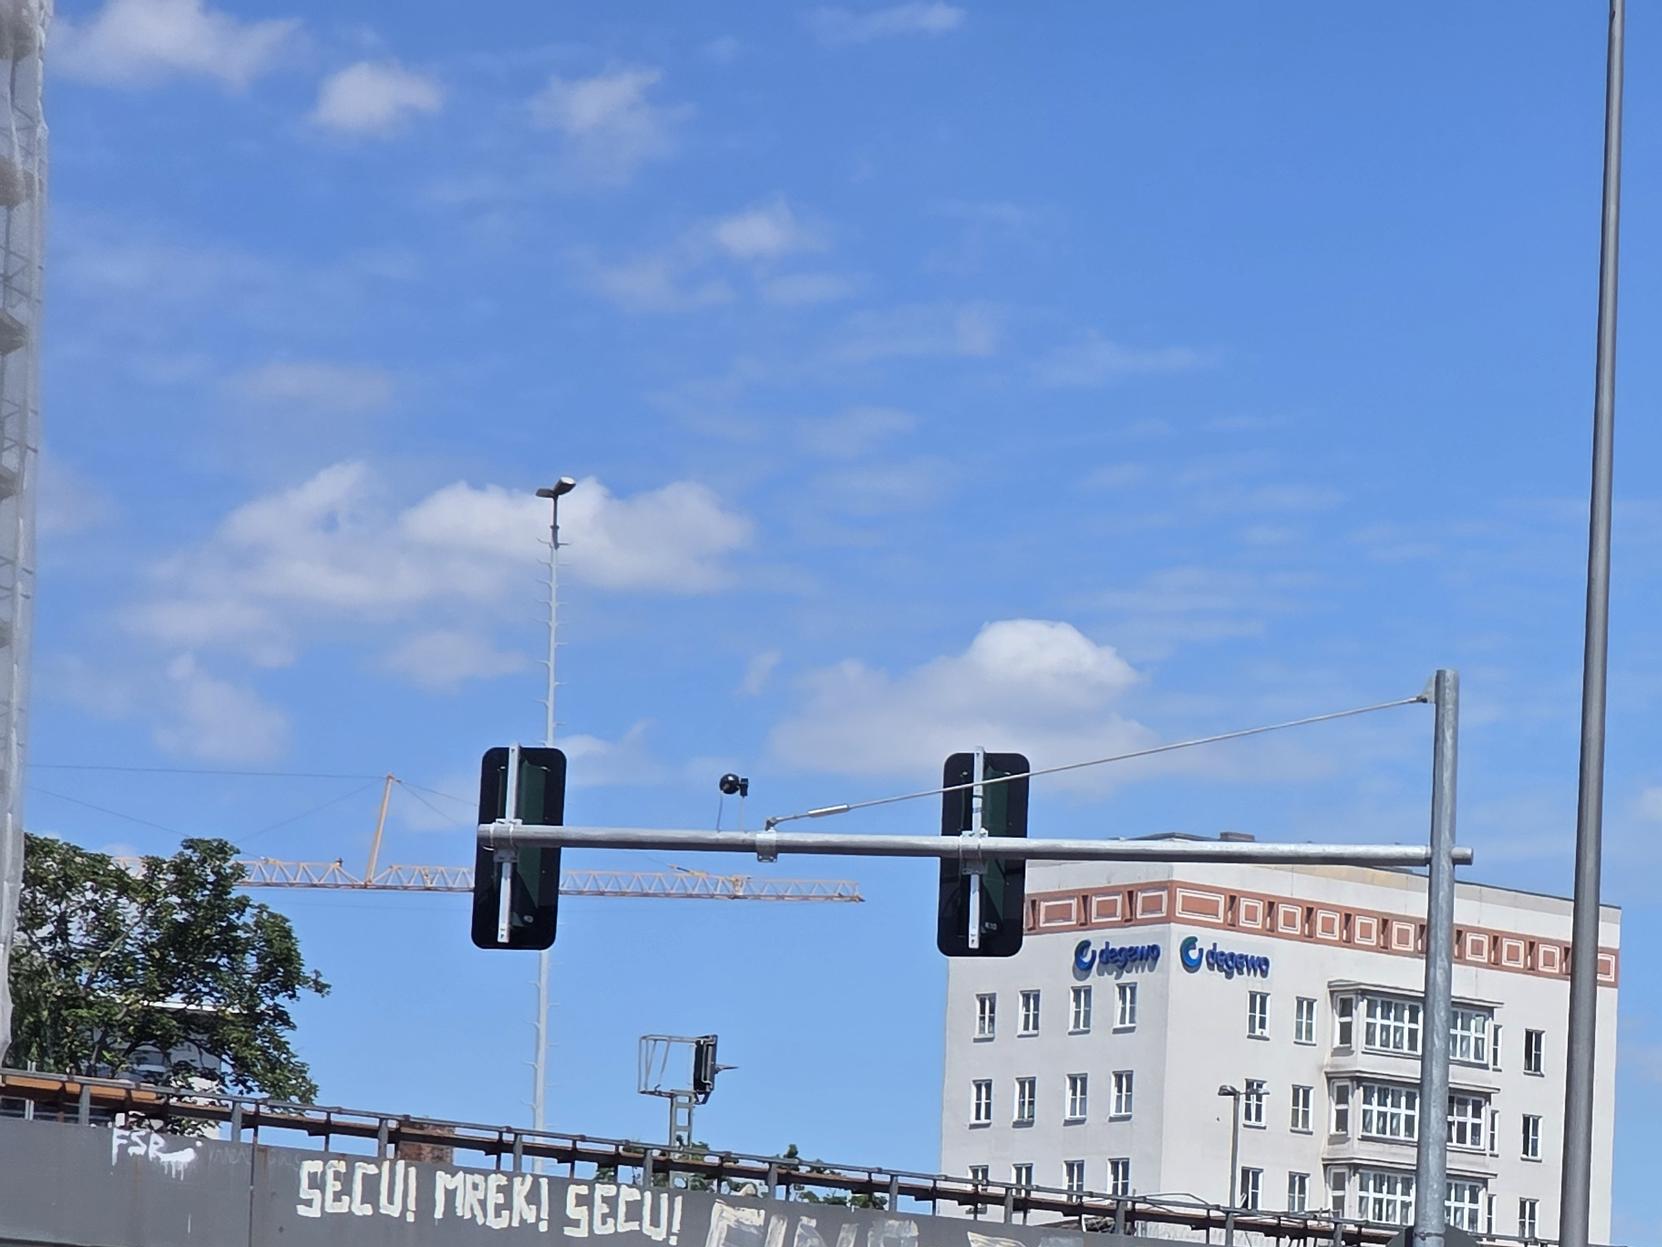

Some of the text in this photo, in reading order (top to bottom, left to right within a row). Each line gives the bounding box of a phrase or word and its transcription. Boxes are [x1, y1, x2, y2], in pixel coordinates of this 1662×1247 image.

[1206, 942, 1270, 979] degewo
[297, 1160, 683, 1246] SECU! MREK! SECU!
